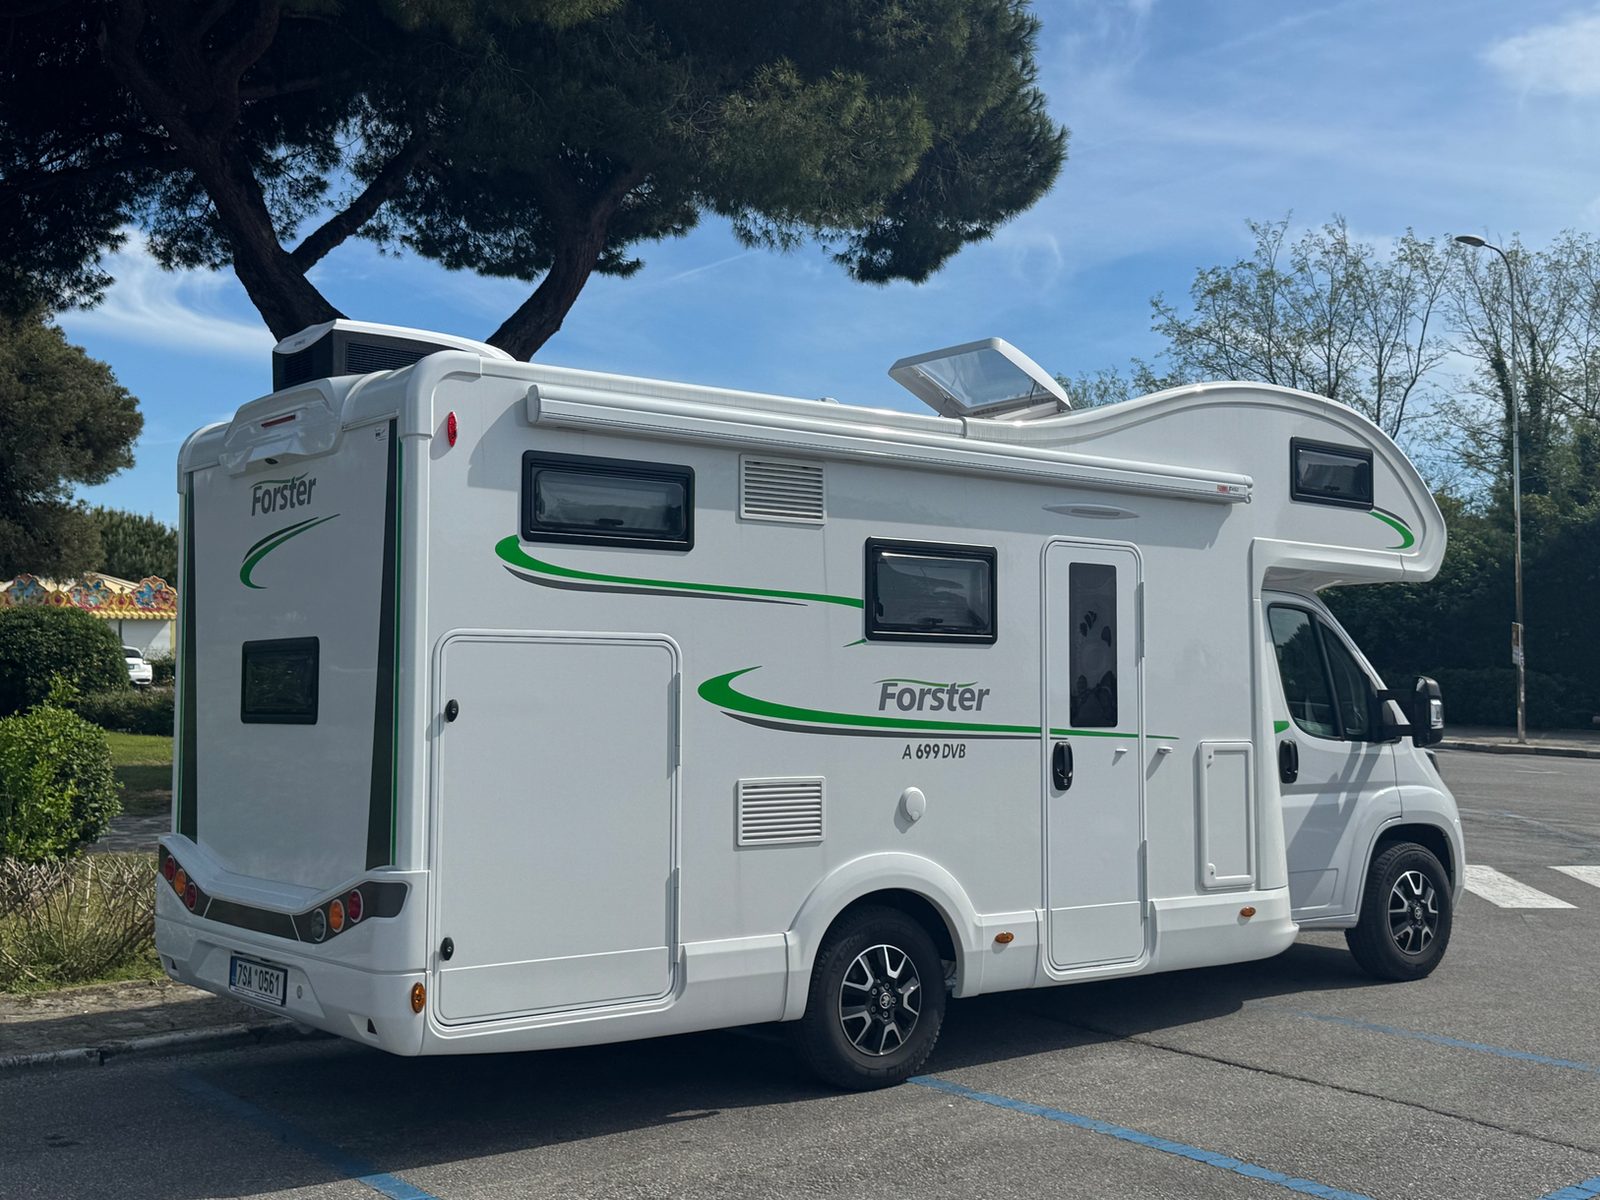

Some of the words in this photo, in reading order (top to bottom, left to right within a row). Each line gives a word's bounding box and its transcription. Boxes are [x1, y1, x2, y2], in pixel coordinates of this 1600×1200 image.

[251, 476, 317, 516] Forster
[878, 682, 990, 712] Forster
[902, 744, 912, 760] A
[916, 743, 940, 760] 699
[942, 743, 966, 759] DVB
[237, 963, 252, 988] 7SA
[258, 969, 280, 996] 0561
